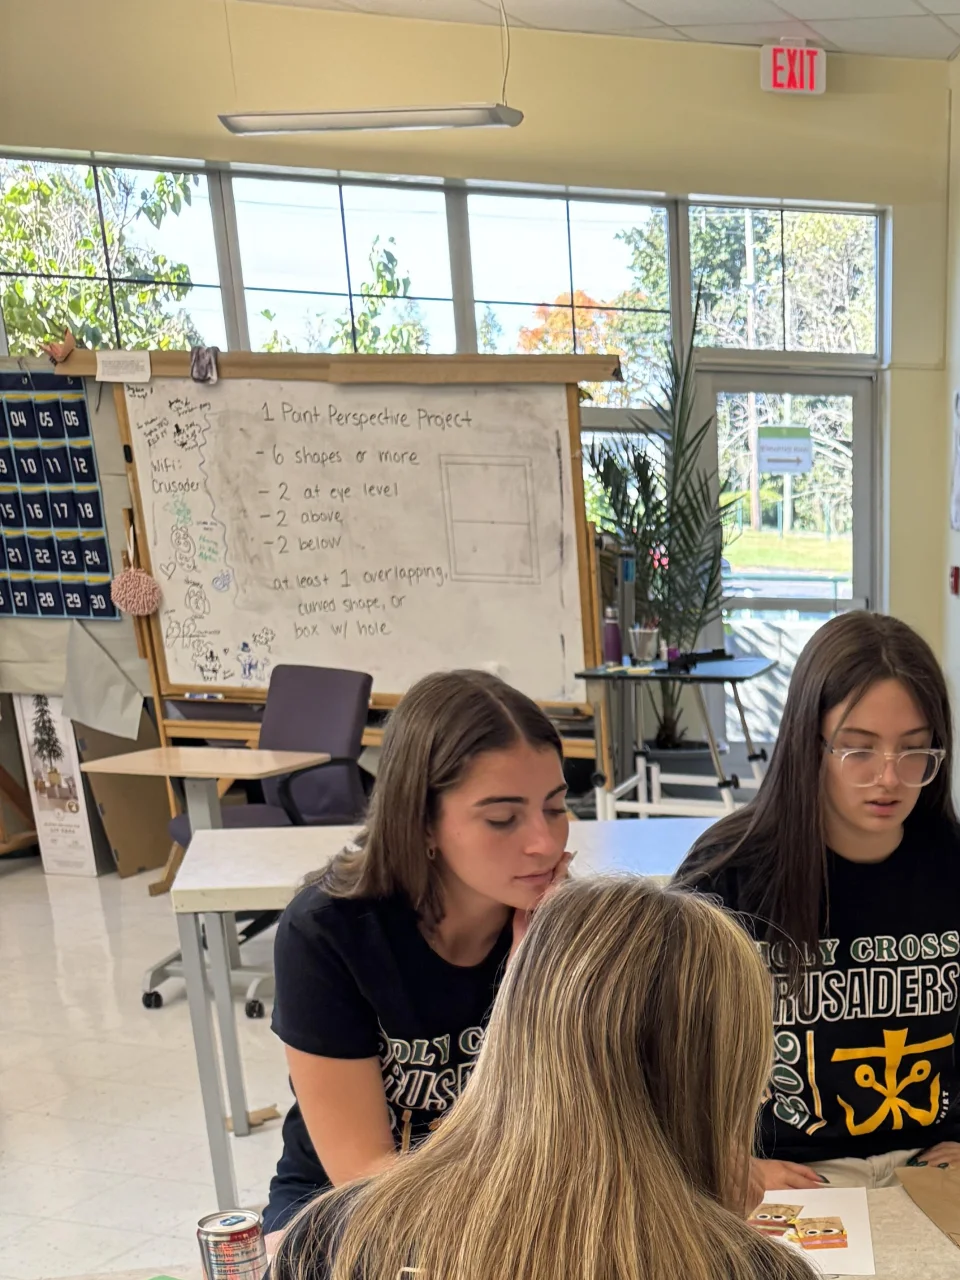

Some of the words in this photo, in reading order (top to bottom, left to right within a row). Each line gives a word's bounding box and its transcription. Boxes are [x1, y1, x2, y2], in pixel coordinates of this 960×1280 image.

[771, 47, 818, 92] EXIT
[10, 411, 27, 427] 04
[39, 411, 54, 427] 05
[64, 410, 79, 427] 06
[261, 401, 275, 422] 1
[328, 404, 410, 431] Perspective
[417, 408, 472, 431] Project
[20, 458, 37, 474] 10
[46, 457, 61, 474] 11
[73, 457, 88, 473] 12
[272, 444, 284, 465] 6
[295, 446, 342, 467] shapes
[379, 451, 420, 466] more
[278, 481, 291, 501] 2
[303, 484, 321, 500] at
[330, 485, 351, 503] eye
[363, 482, 399, 497] level
[0, 503, 15, 519] 15
[27, 503, 43, 519] 16
[54, 503, 68, 519] 17
[78, 503, 94, 519] 18
[276, 509, 289, 527] 2
[298, 535, 342, 551] below
[8, 548, 22, 562] 21
[35, 548, 51, 563] 22
[61, 550, 77, 565] 23
[85, 550, 100, 565] 24
[273, 576, 290, 591] at
[297, 574, 329, 589] least
[341, 569, 351, 588] 1
[14, 591, 28, 607] 27
[38, 592, 55, 607] 28
[65, 593, 82, 608] 29
[90, 594, 106, 609] 30
[294, 622, 319, 639] box
[356, 620, 392, 636] hole
[850, 930, 960, 963] CROSS
[773, 962, 960, 1025] RUSADERS
[380, 1033, 450, 1066] OLY
